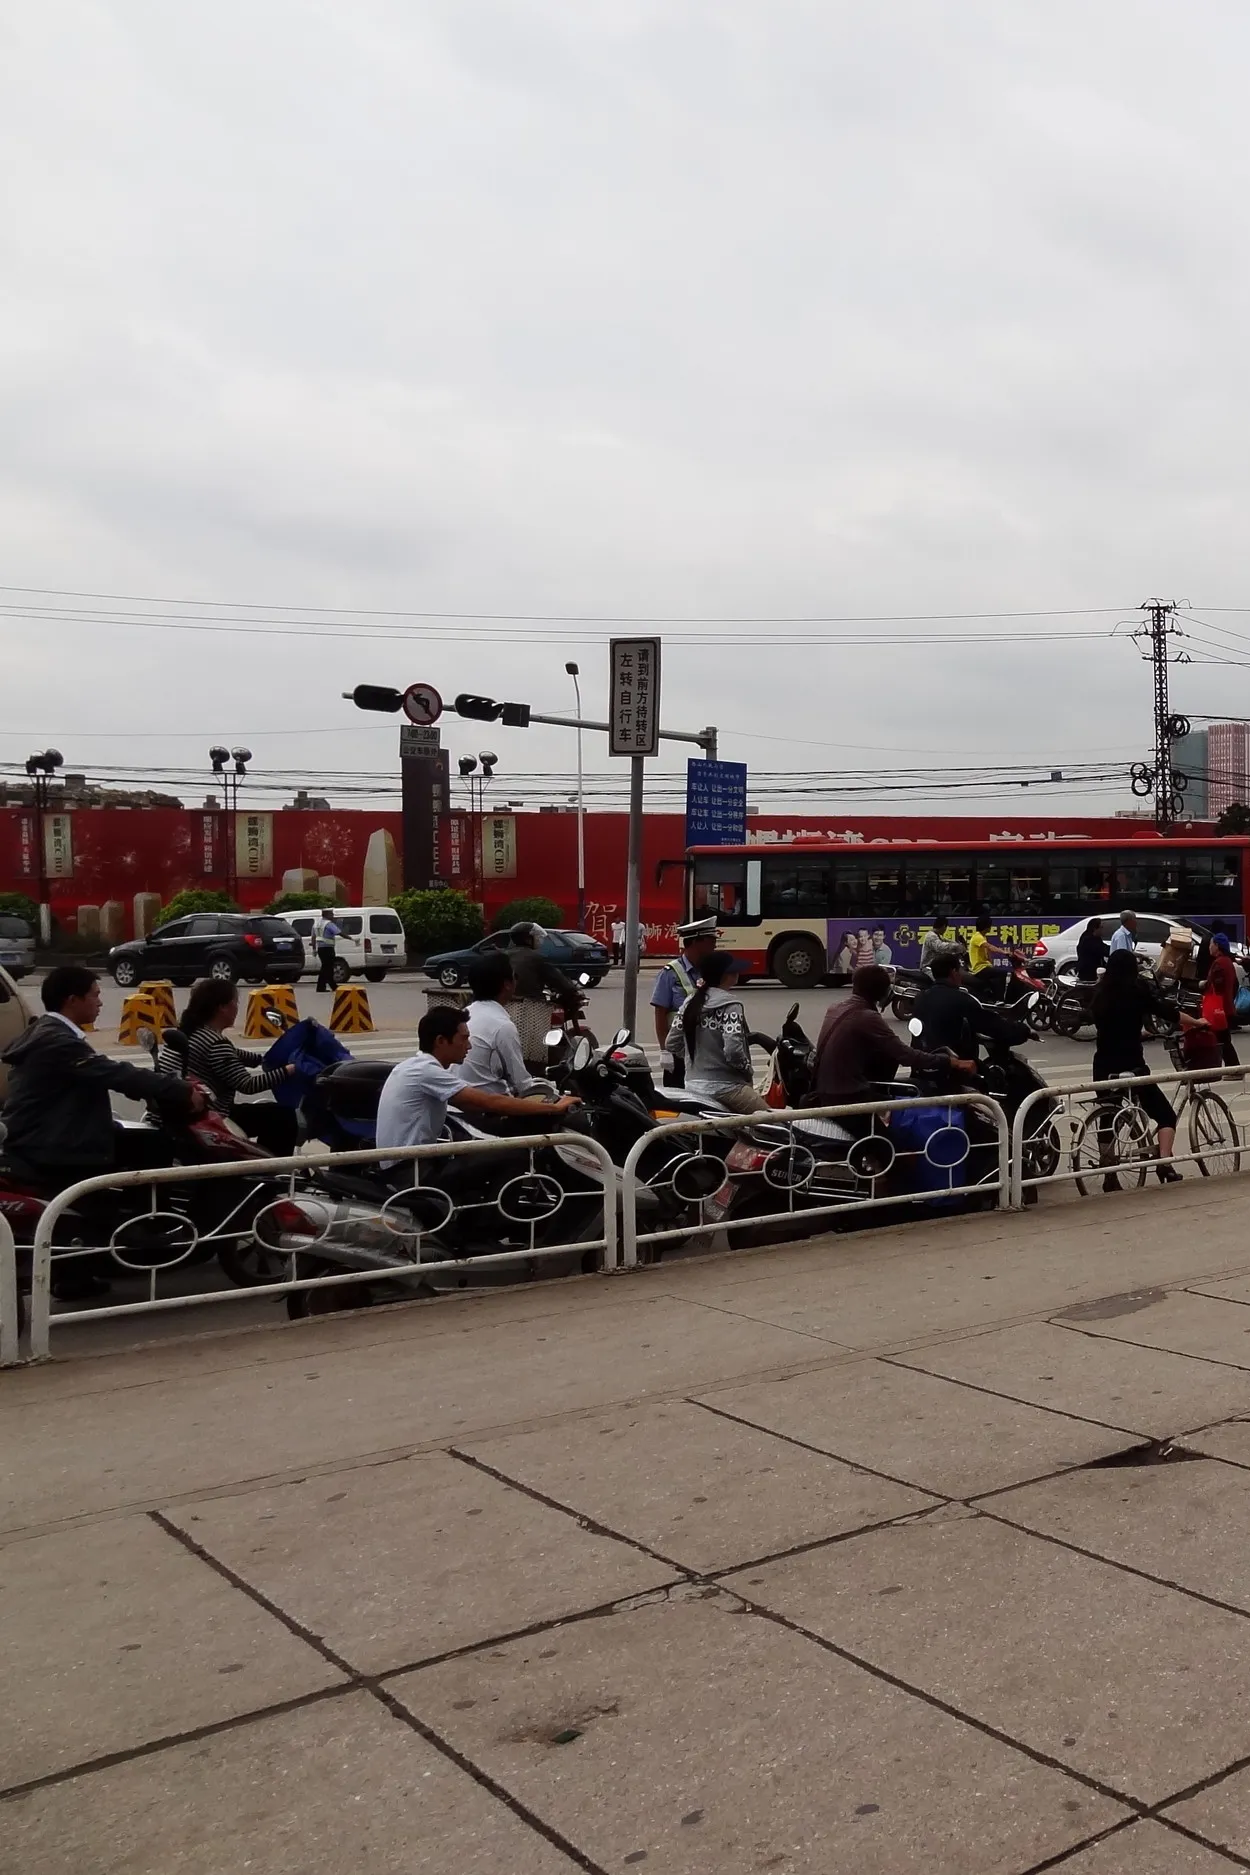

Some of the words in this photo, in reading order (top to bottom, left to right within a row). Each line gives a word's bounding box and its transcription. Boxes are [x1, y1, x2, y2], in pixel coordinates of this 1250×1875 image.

[619, 652, 633, 742] 左转自行车
[635, 648, 649, 747] 请到前方待转区
[493, 819, 505, 874] 螺蛳湾CBD
